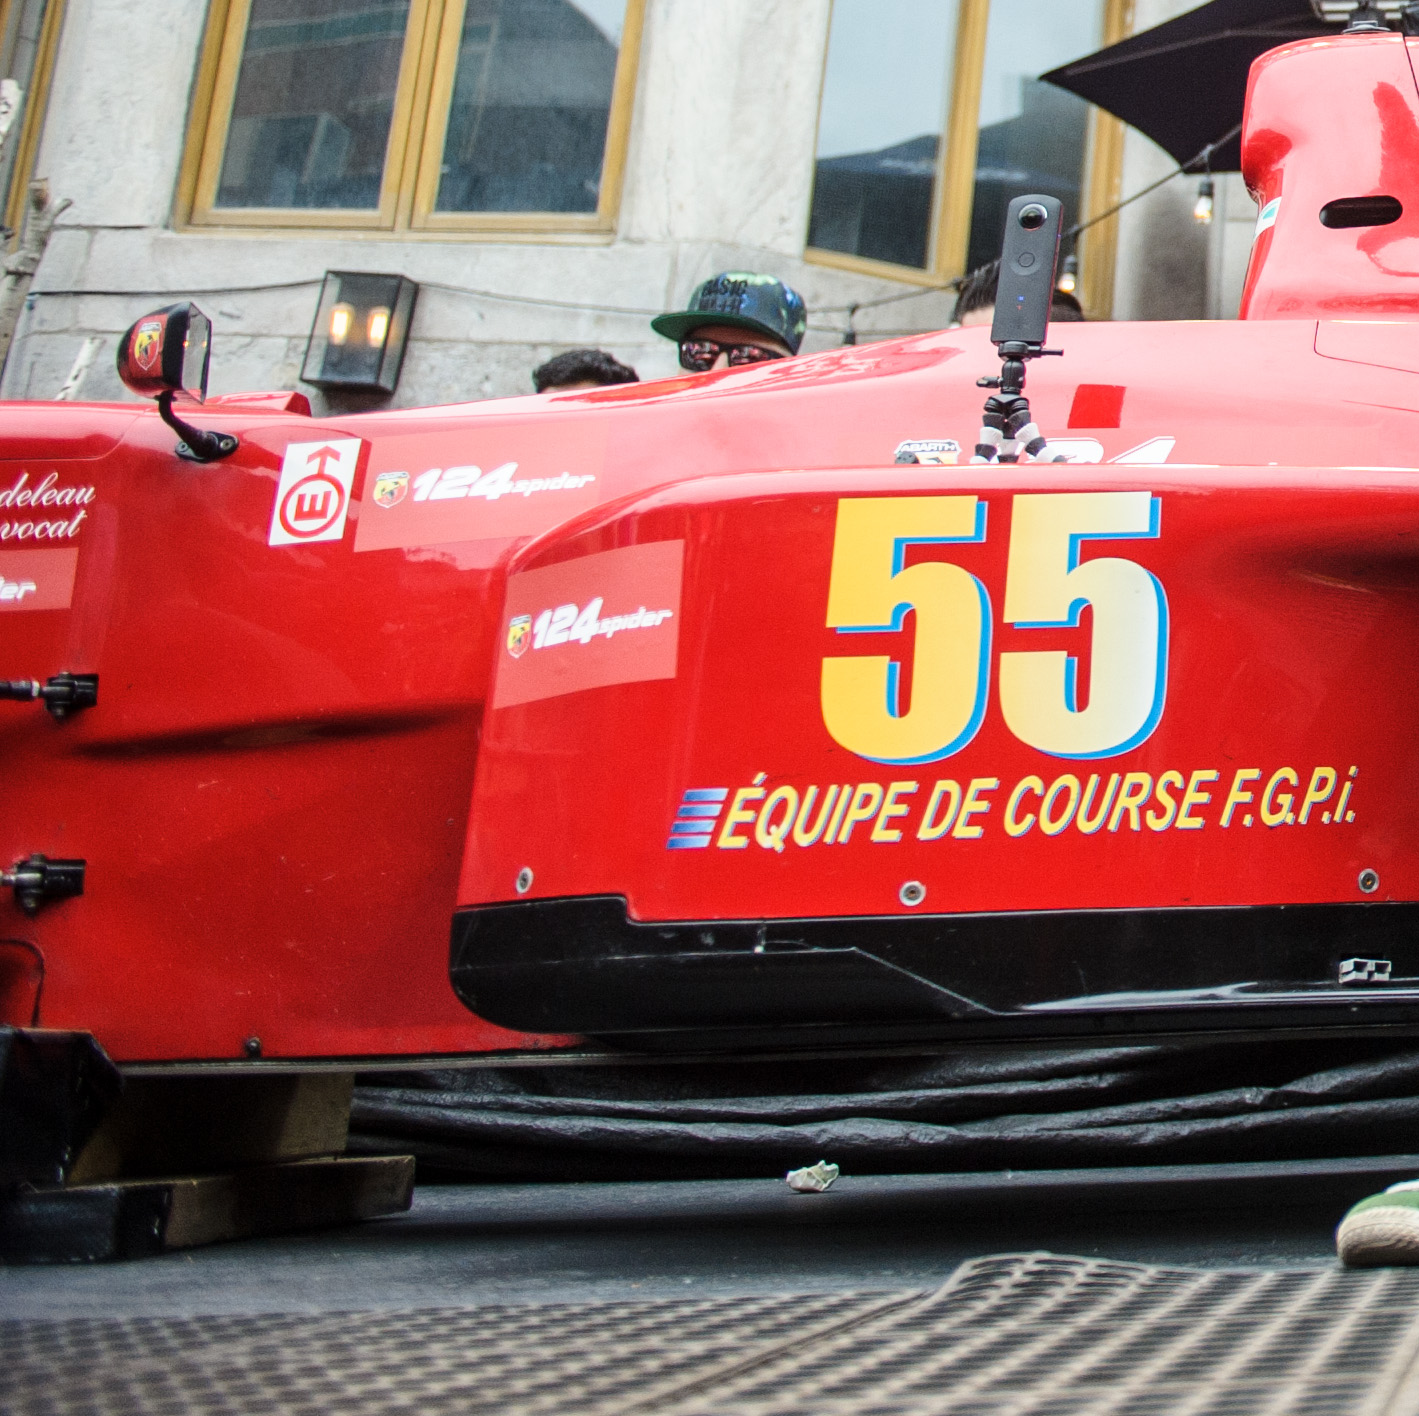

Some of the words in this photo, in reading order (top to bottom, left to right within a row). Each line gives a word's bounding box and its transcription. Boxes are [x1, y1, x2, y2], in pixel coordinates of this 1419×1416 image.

[898, 441, 958, 453] ABARTH
[0, 472, 95, 507] deleau
[413, 462, 519, 502] 124
[512, 472, 596, 497] spider
[0, 510, 88, 540] vocat
[532, 596, 604, 650] 124
[595, 606, 673, 639] spider
[820, 491, 1170, 766] 55
[719, 772, 919, 853] ÉQUIPE
[917, 777, 1000, 841] DE
[1003, 769, 1220, 838] COURSE
